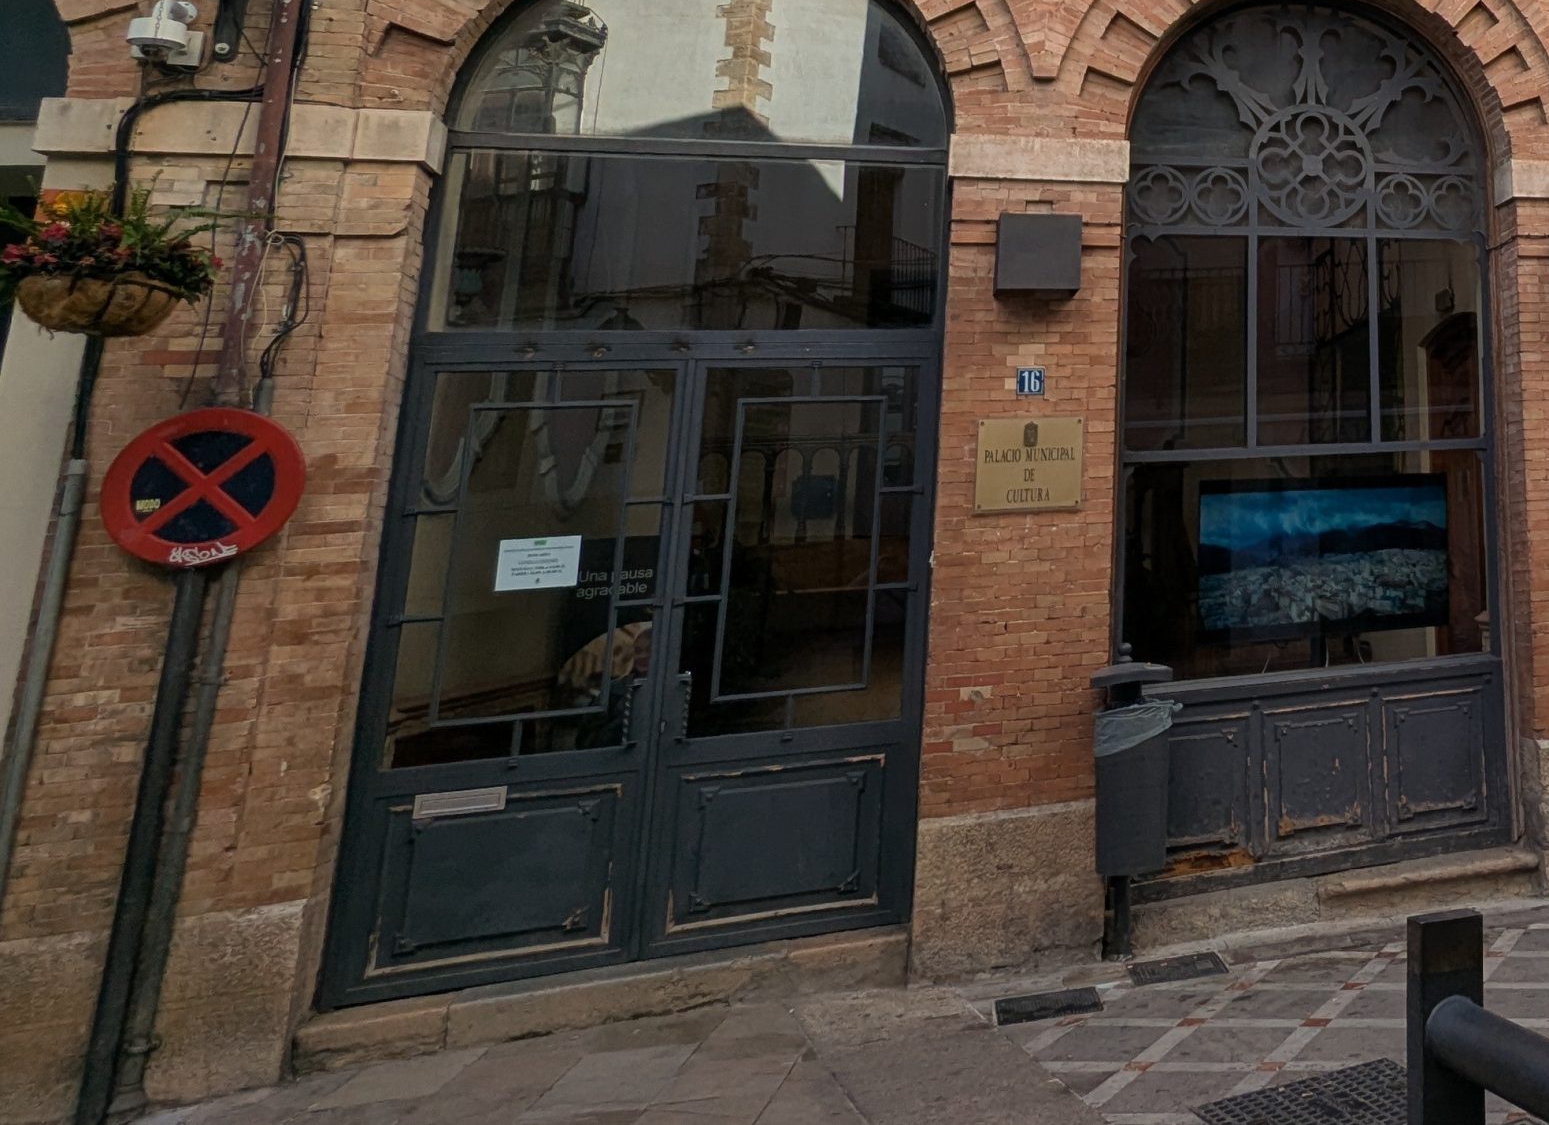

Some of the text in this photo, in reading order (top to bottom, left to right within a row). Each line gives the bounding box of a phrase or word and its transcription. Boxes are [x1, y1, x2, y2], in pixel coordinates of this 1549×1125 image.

[1022, 371, 1040, 392] 16
[984, 446, 1076, 464] PALACIO MUNICIPAL
[1023, 468, 1035, 482] DE
[1006, 487, 1050, 503] CULTURA
[579, 570, 607, 583] Una
